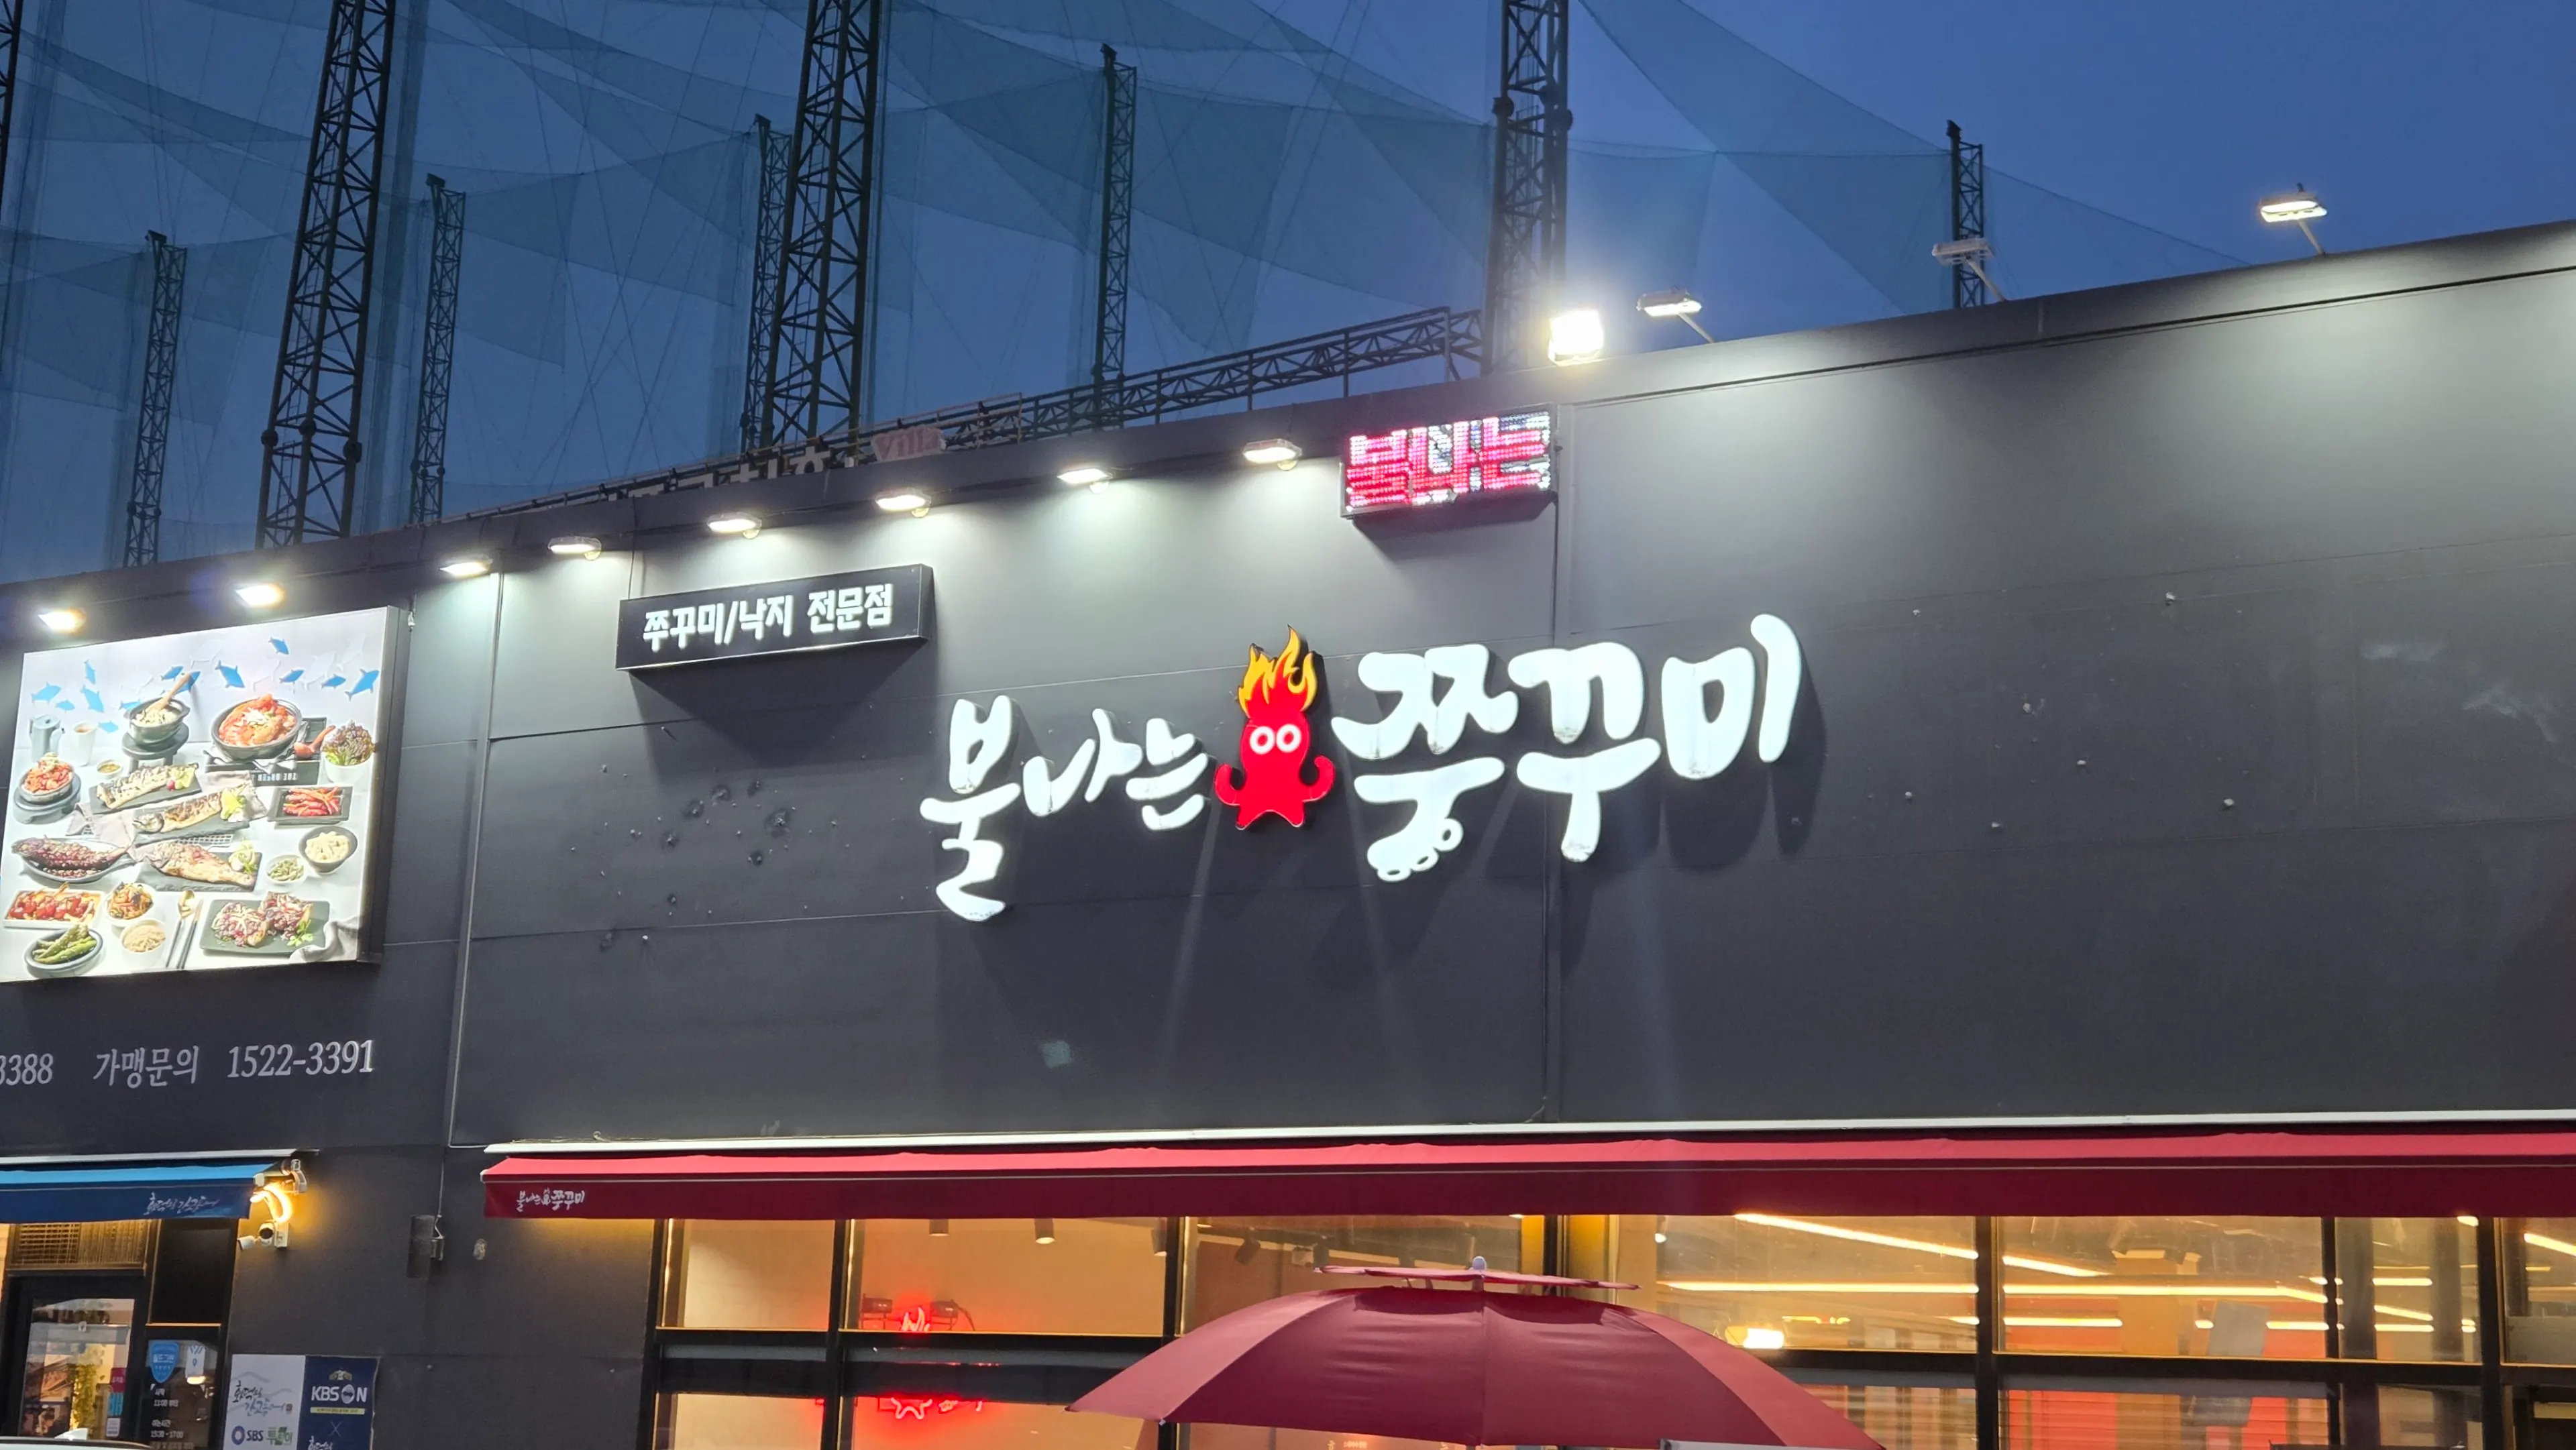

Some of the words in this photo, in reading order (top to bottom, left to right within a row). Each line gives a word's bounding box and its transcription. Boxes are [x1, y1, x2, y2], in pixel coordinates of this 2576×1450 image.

[875, 426, 941, 459] Villa
[642, 594, 794, 653] 쭈꾸미/낙지
[806, 582, 895, 634] 전문점
[920, 695, 1210, 922] 불나는
[93, 1045, 199, 1089] 가맹문의
[227, 1040, 374, 1078] 1522-3391
[246, 1429, 264, 1441] SBS
